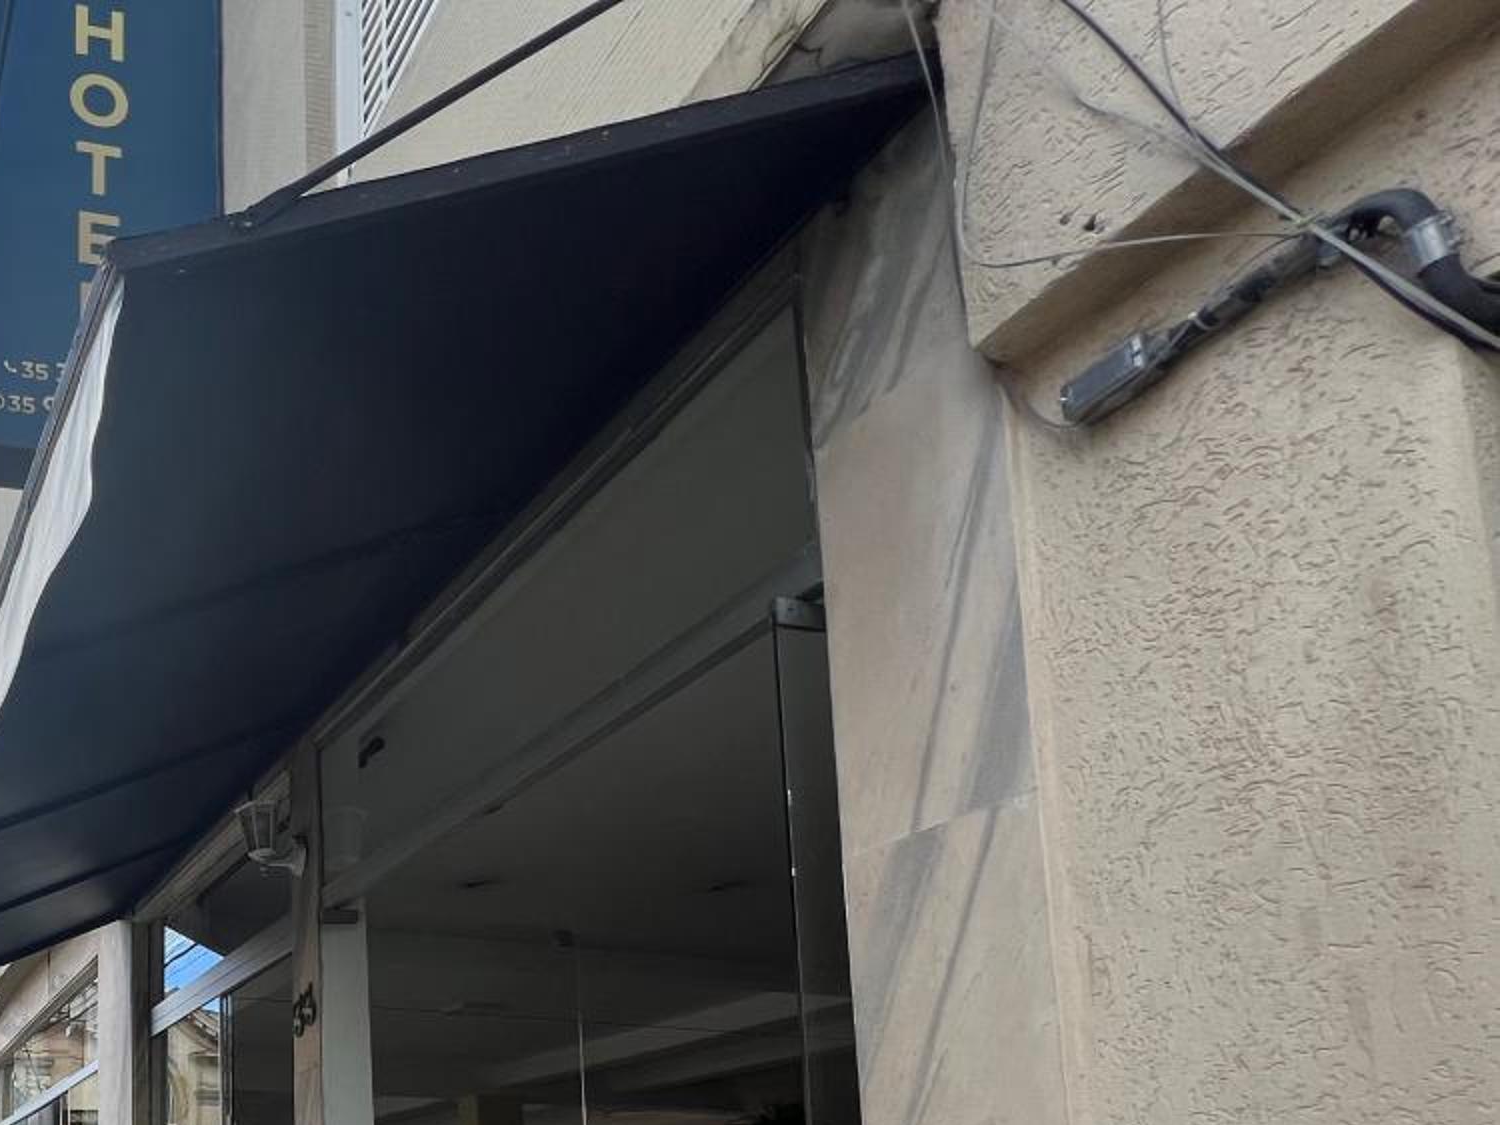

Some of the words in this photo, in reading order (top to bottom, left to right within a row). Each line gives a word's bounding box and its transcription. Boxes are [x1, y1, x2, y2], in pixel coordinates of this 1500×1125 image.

[69, 4, 130, 323] HOTE
[20, 360, 50, 382] 35
[6, 394, 36, 415] 35
